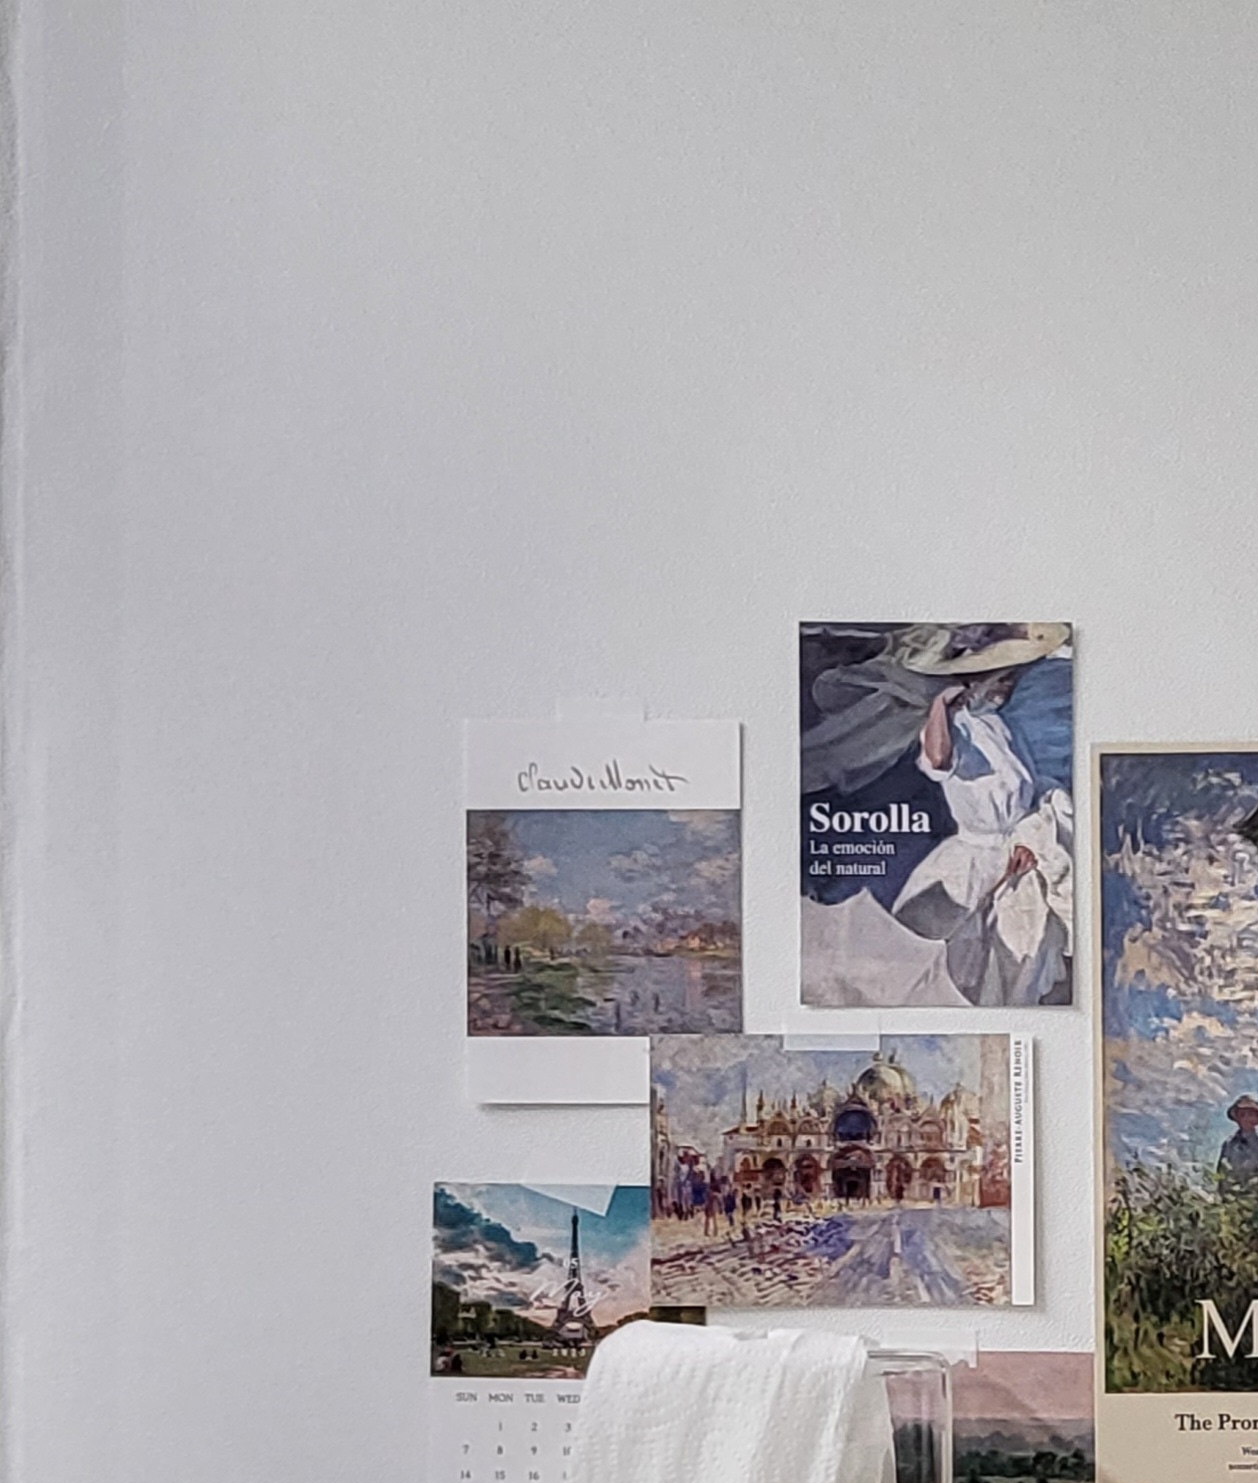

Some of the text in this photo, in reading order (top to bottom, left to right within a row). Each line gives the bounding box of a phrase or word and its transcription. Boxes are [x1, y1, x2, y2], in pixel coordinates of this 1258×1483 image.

[809, 802, 931, 833] Sorolla
[809, 840, 896, 855] La emoción
[809, 860, 886, 875] del natural
[456, 1392, 580, 1404] SUN MON TUE WED
[530, 1422, 538, 1432] 2
[564, 1422, 572, 1432] 3
[1175, 1413, 1213, 1430] The
[462, 1444, 470, 1455] 7
[497, 1445, 503, 1455] 8
[530, 1446, 538, 1455] 9
[460, 1470, 540, 1480] 14 15 16
